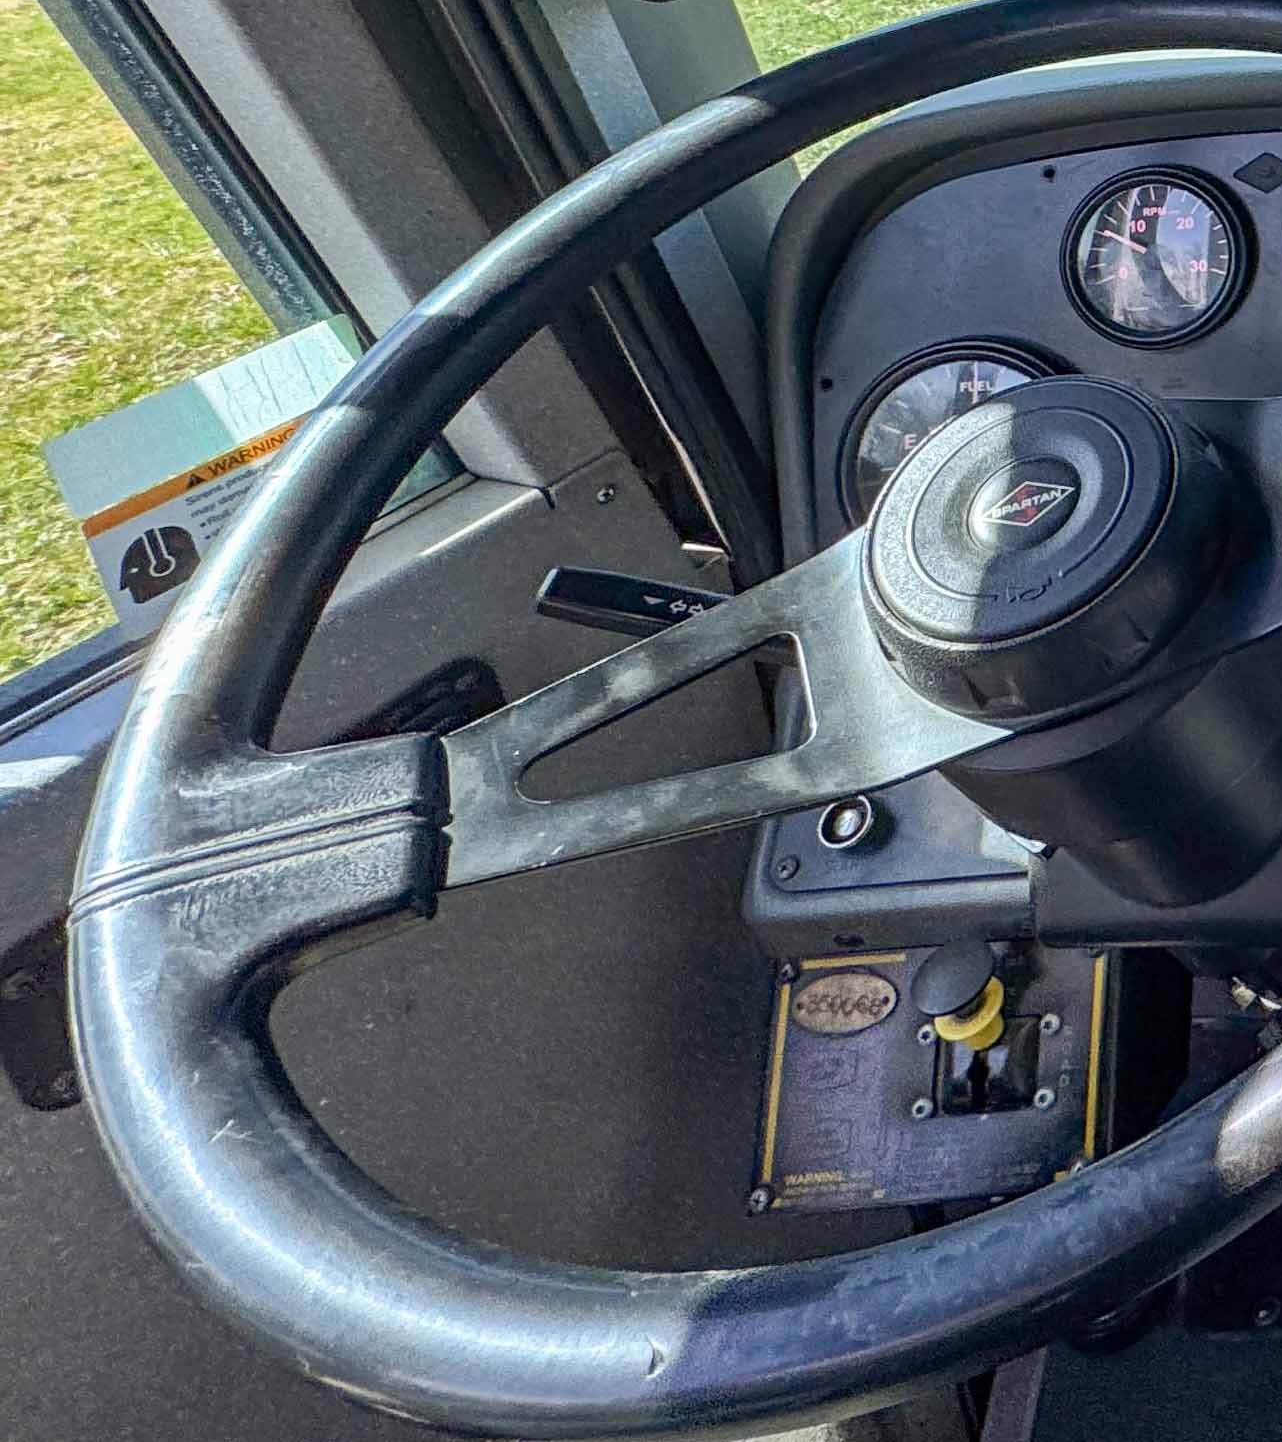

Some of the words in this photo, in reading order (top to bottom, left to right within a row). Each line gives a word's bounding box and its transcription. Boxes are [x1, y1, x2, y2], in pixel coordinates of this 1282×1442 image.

[1143, 207, 1168, 217] RPM
[1130, 220, 1146, 233] 10
[1176, 217, 1195, 230] 20
[1190, 260, 1208, 272] 30
[960, 381, 996, 393] FUEL
[903, 433, 918, 450] E
[991, 489, 1063, 518] SPARTAN
